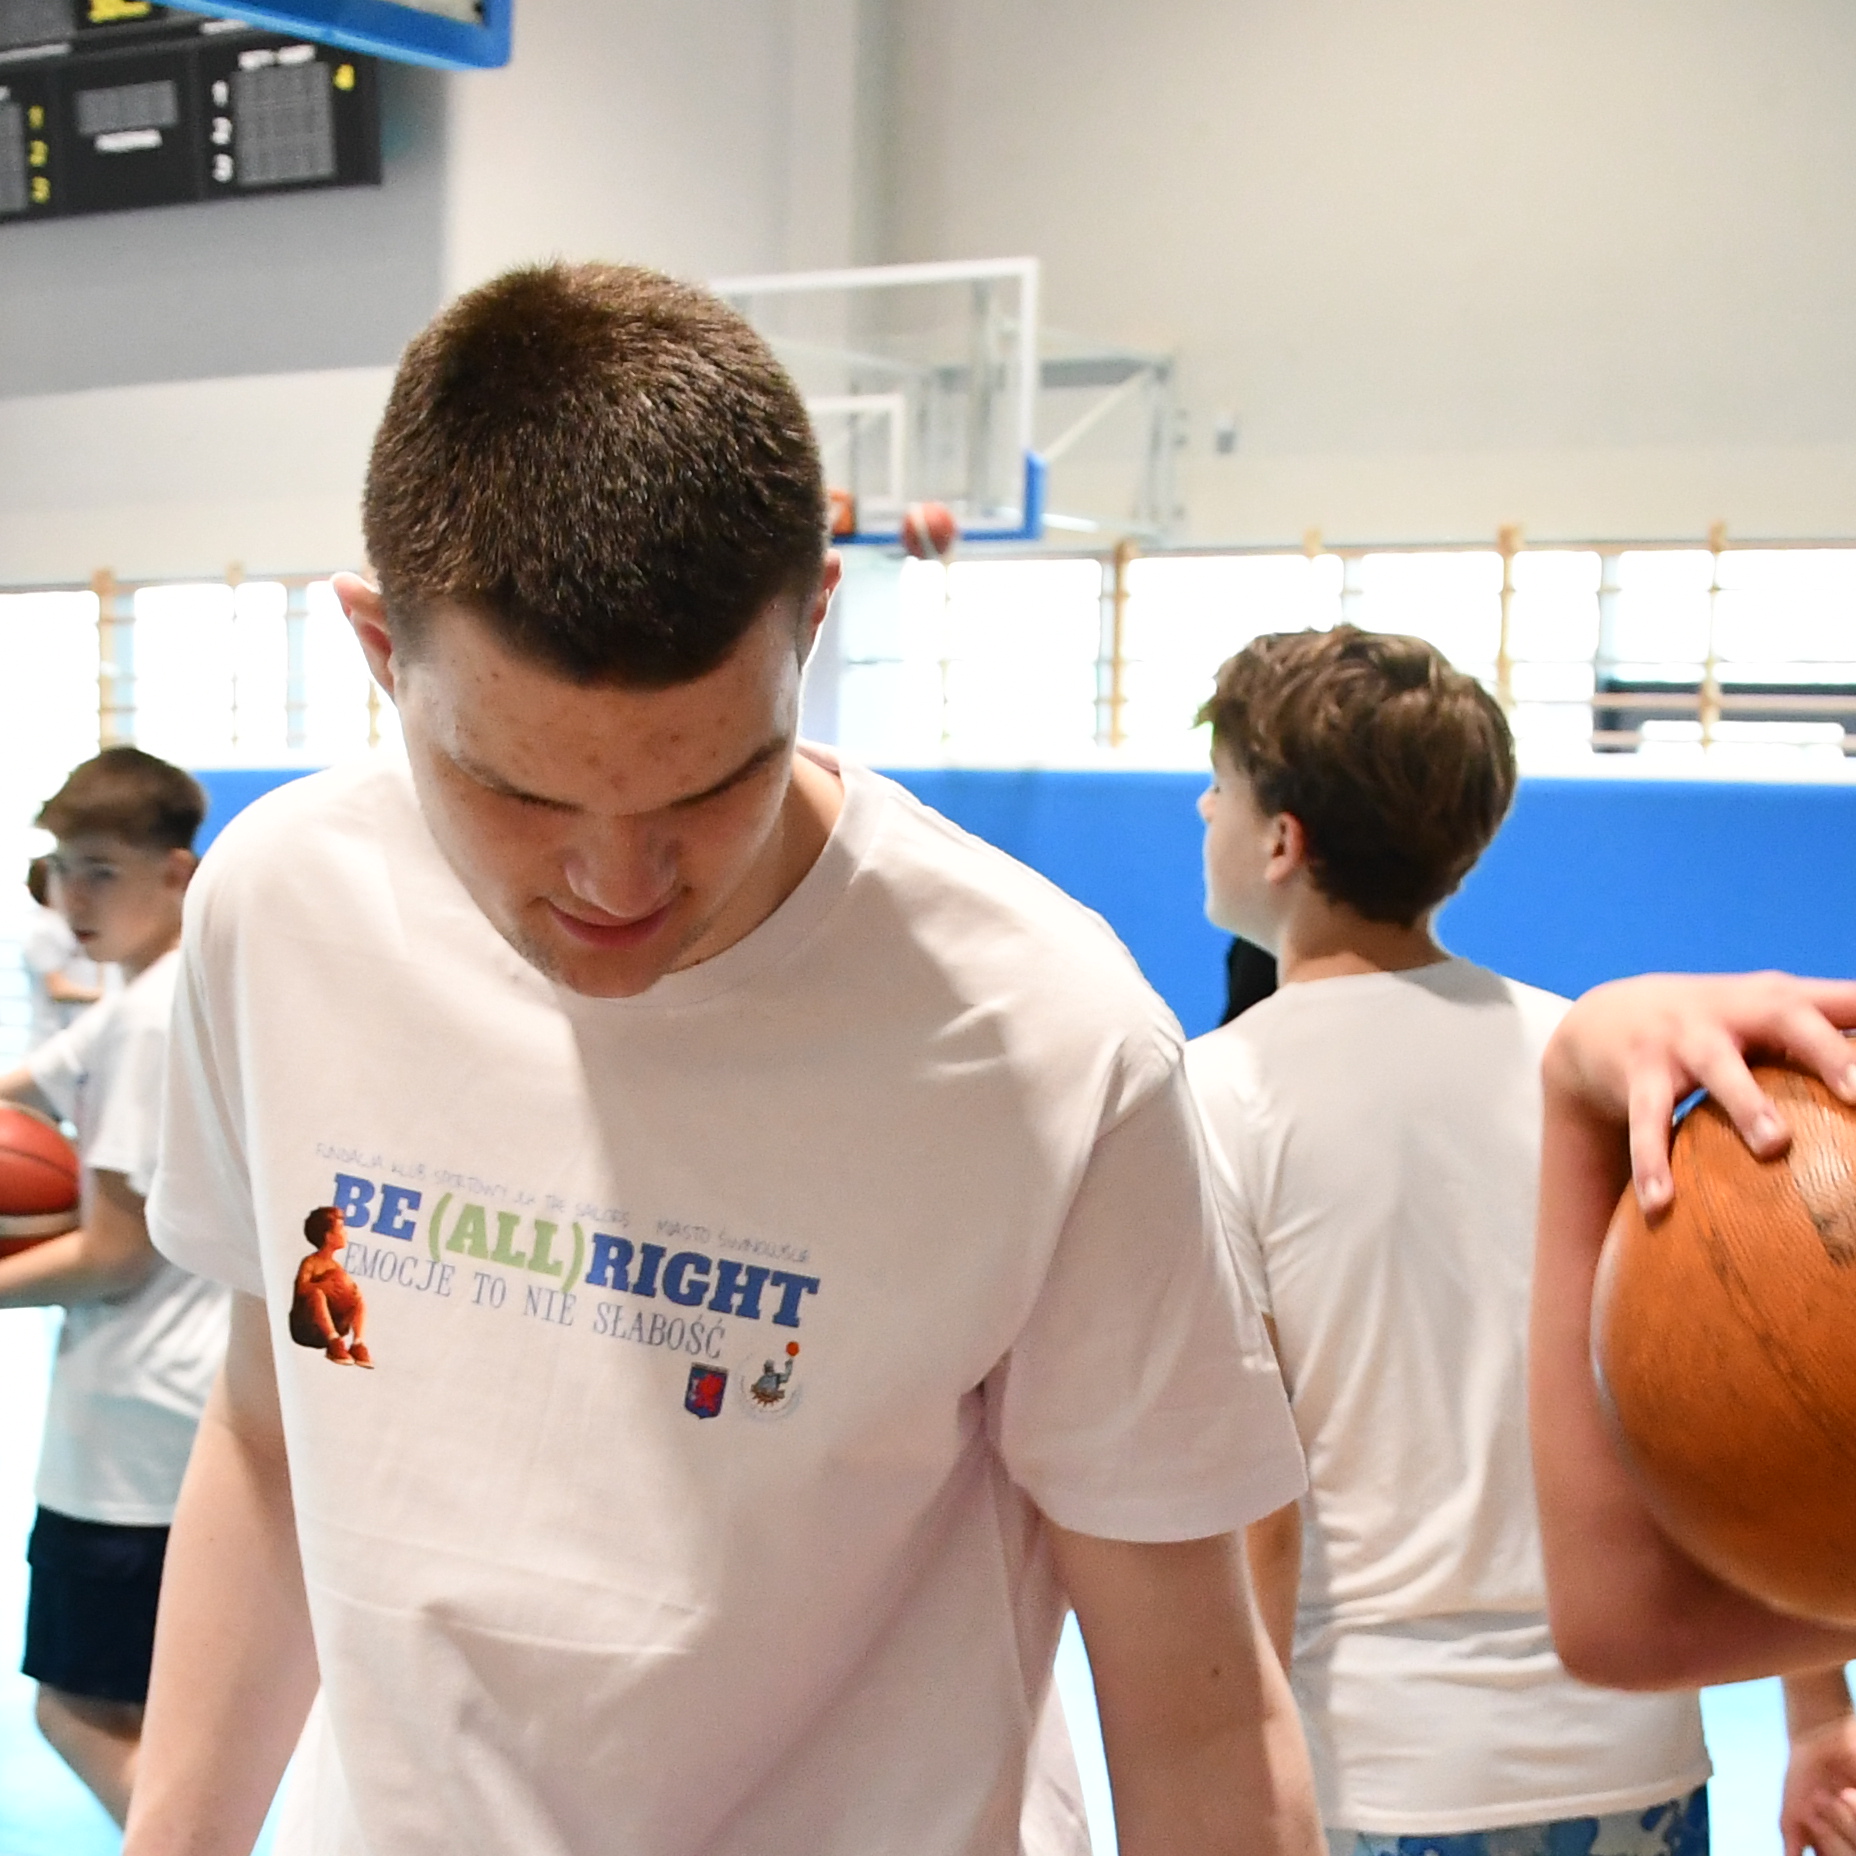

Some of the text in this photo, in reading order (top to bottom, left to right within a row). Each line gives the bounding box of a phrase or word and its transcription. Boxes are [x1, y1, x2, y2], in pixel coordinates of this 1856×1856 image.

[332, 1172, 422, 1241] BE
[344, 1242, 726, 1358] EMOCJE TO NIE SŁABOŚĆ
